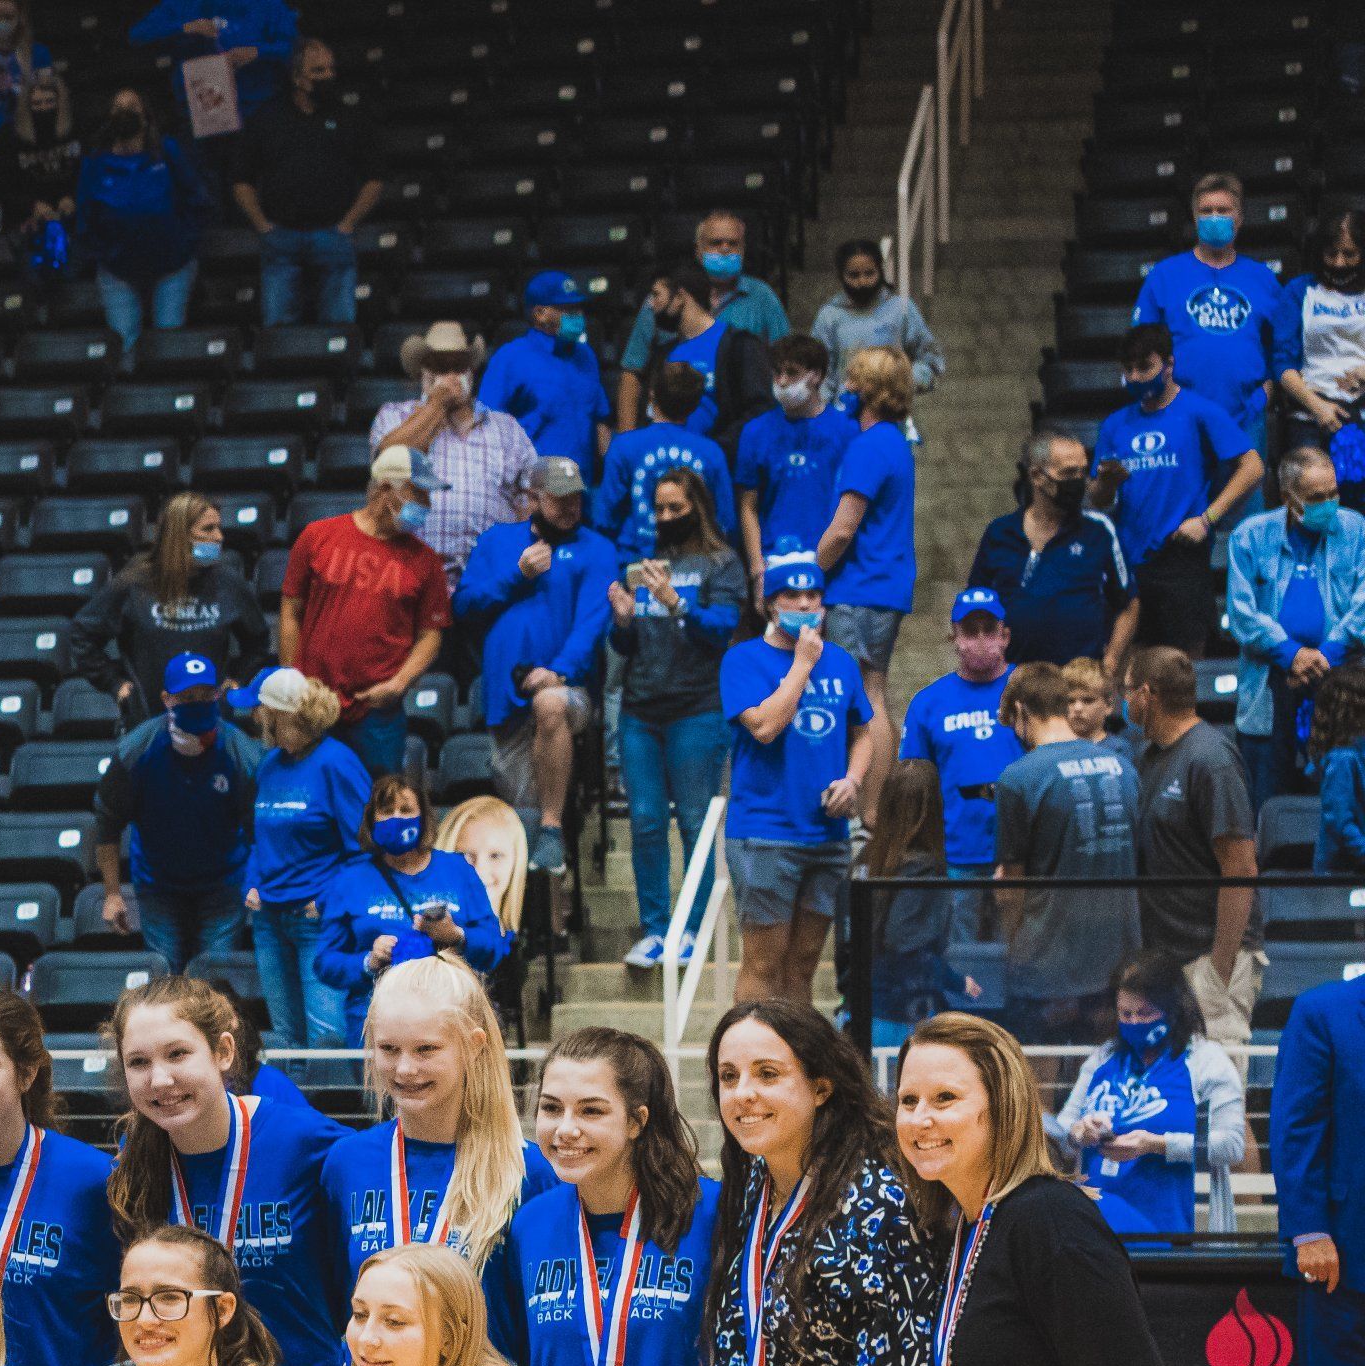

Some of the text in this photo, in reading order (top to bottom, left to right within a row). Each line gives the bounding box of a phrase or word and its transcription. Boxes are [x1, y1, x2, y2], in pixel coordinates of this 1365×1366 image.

[326, 546, 402, 597] USA
[235, 1256, 273, 1268] ACK
[4, 1271, 34, 1286] ACK
[537, 1307, 664, 1324] BACK ACK
